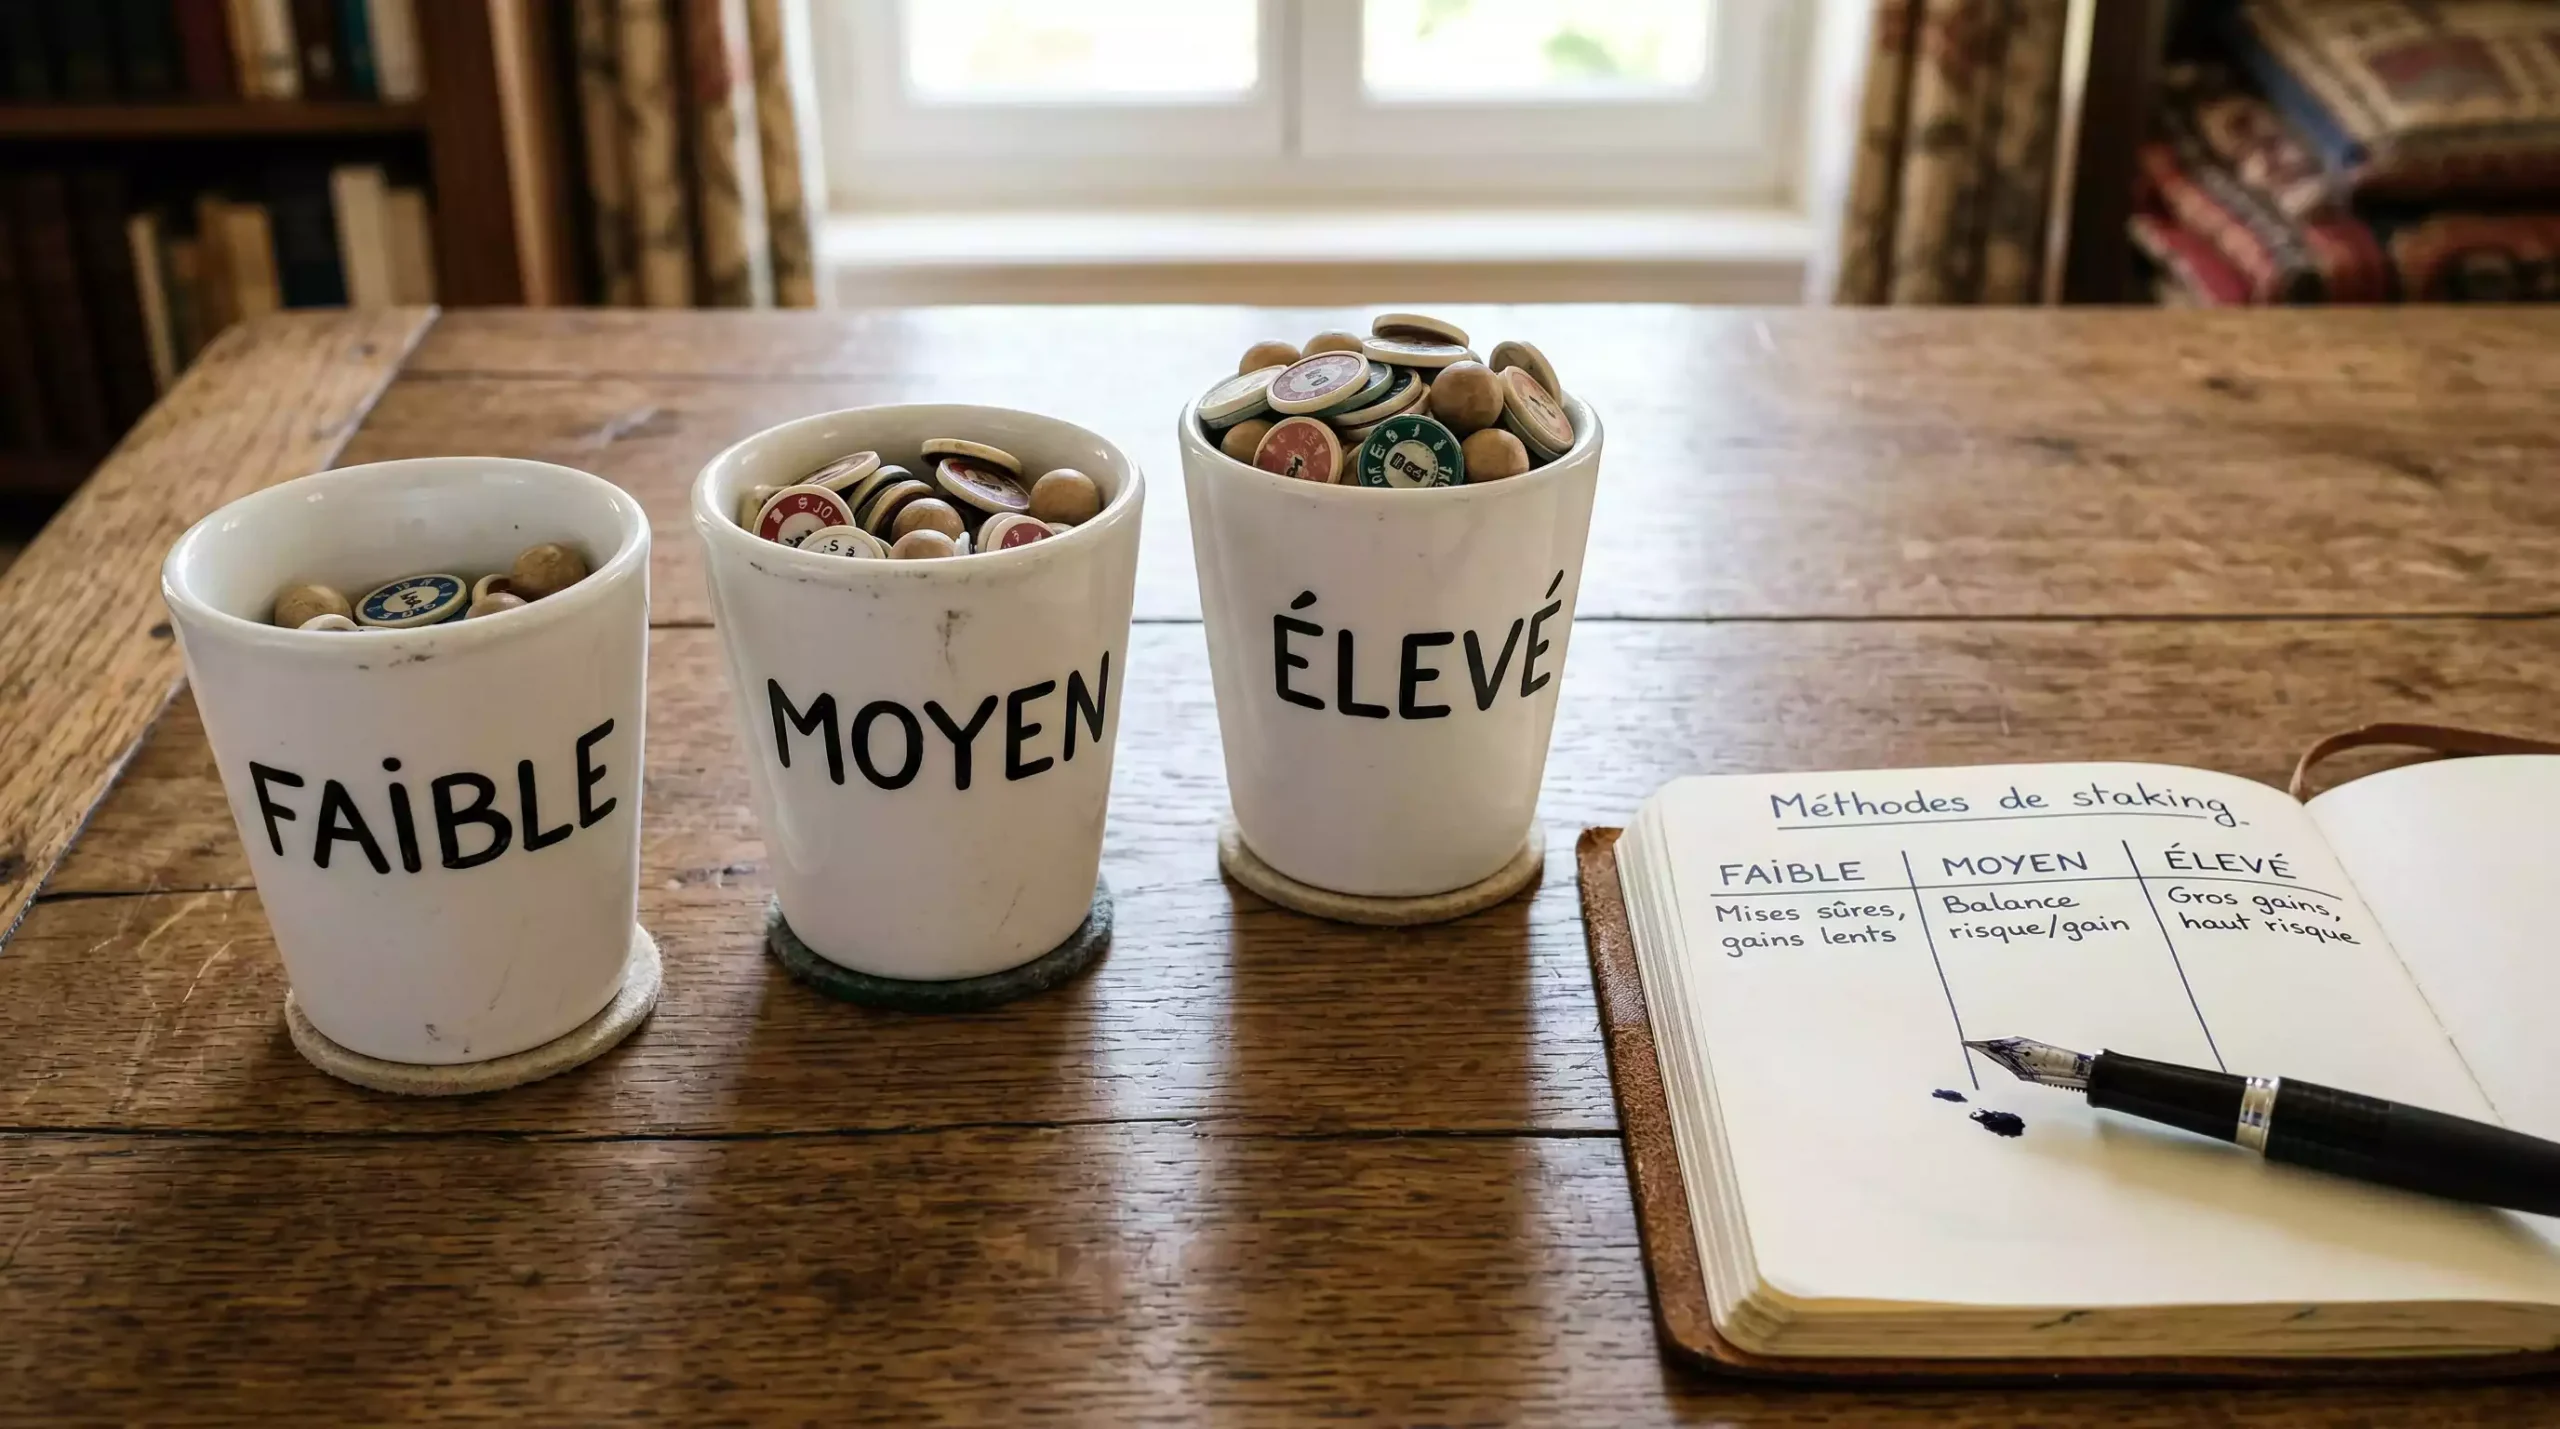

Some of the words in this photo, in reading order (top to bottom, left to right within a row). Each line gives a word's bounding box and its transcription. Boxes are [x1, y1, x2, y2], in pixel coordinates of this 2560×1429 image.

[1273, 569, 1564, 720] ÉLEVÉ
[767, 650, 1110, 791] MOYEN
[1770, 789, 1970, 820] Méthodes
[1998, 785, 2050, 810] de
[1941, 850, 2089, 877] MOYEN
[2163, 841, 2297, 880] ÉLEVÉ
[1714, 904, 1801, 923] Mises
[1816, 899, 1906, 922] sûres,
[1941, 891, 2081, 914] Balance
[2167, 885, 2239, 906] Gros
[2251, 894, 2342, 923] gains,
[1721, 931, 1805, 959] gains
[1820, 924, 1897, 945] lents
[1948, 913, 2131, 944] risque/gain
[2177, 911, 2251, 931] haut
[2263, 918, 2362, 945] risque
